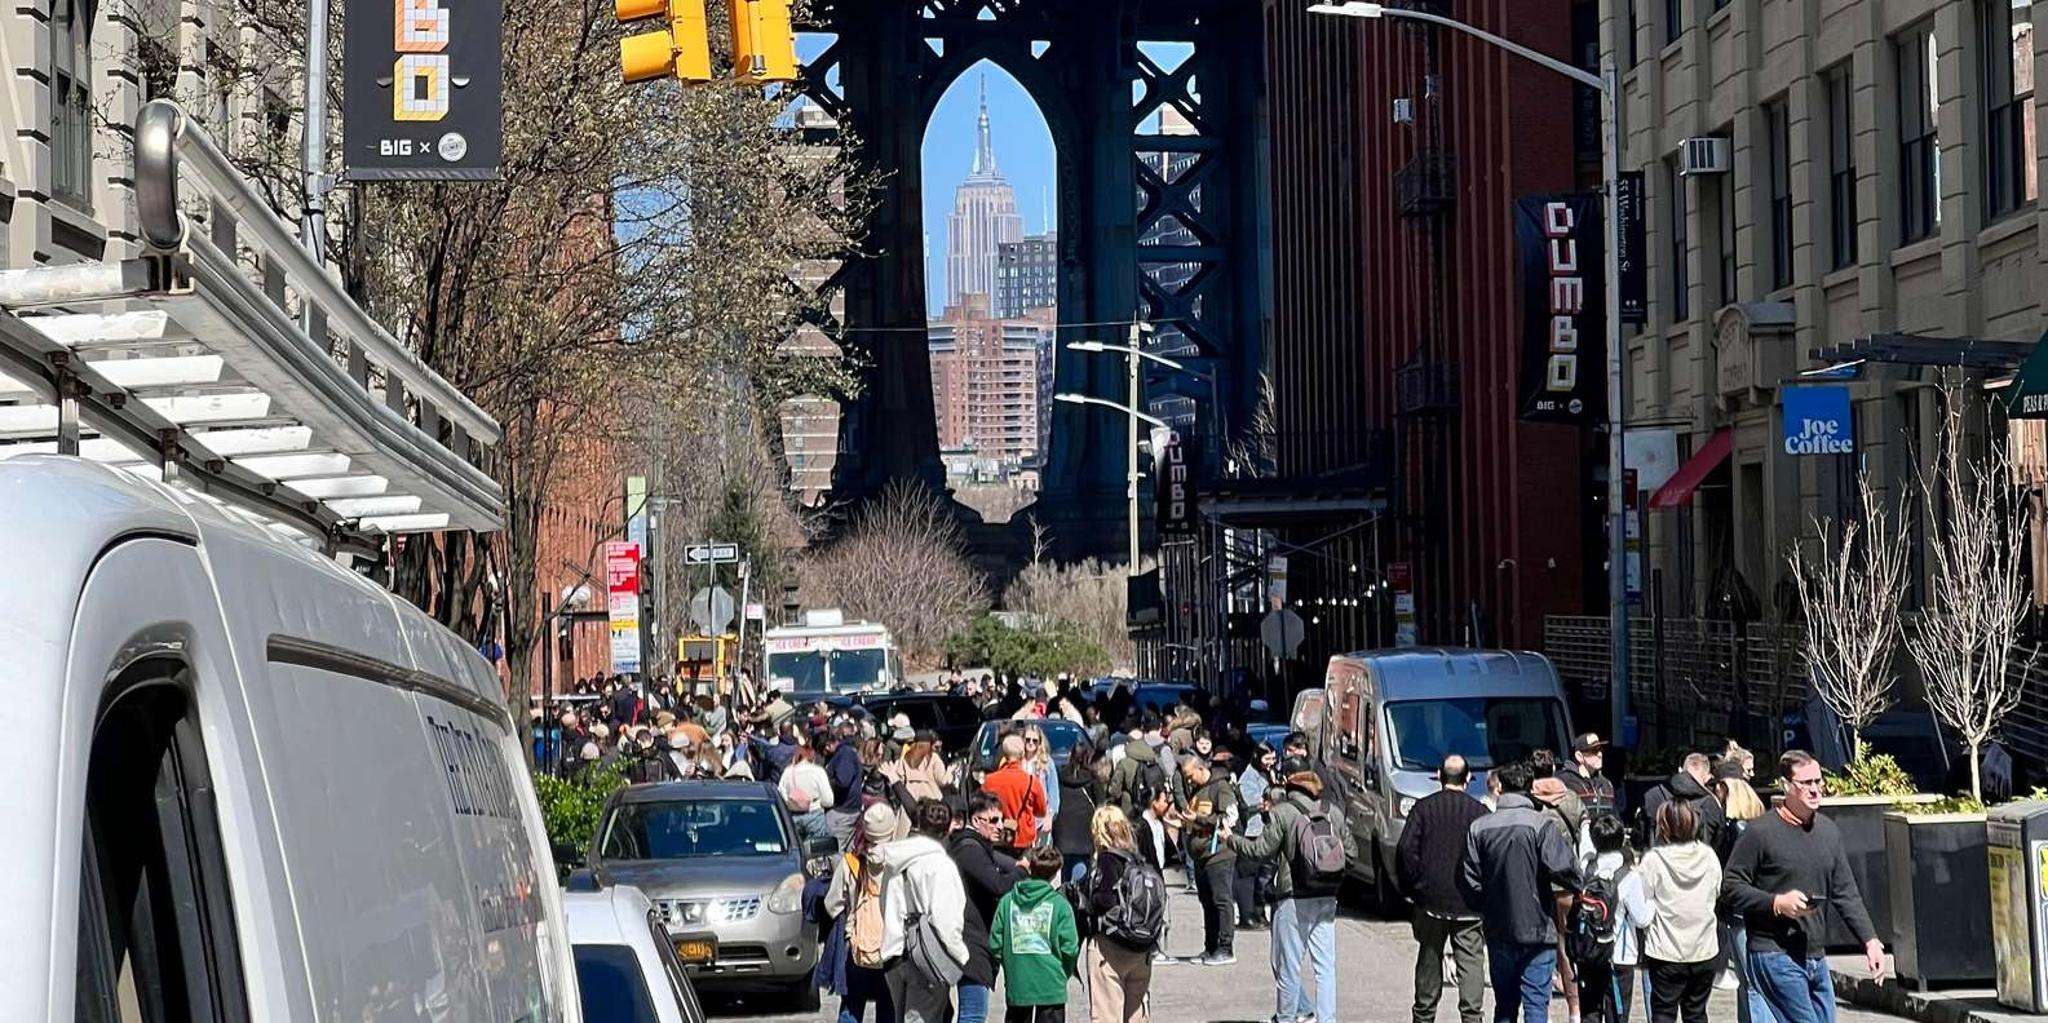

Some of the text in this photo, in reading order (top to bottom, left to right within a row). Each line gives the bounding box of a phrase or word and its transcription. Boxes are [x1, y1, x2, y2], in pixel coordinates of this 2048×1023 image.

[380, 139, 412, 156] BIG
[1543, 202, 1583, 392] DUMBO
[1799, 418, 1839, 439] Joe
[1785, 434, 1853, 455] Coffee
